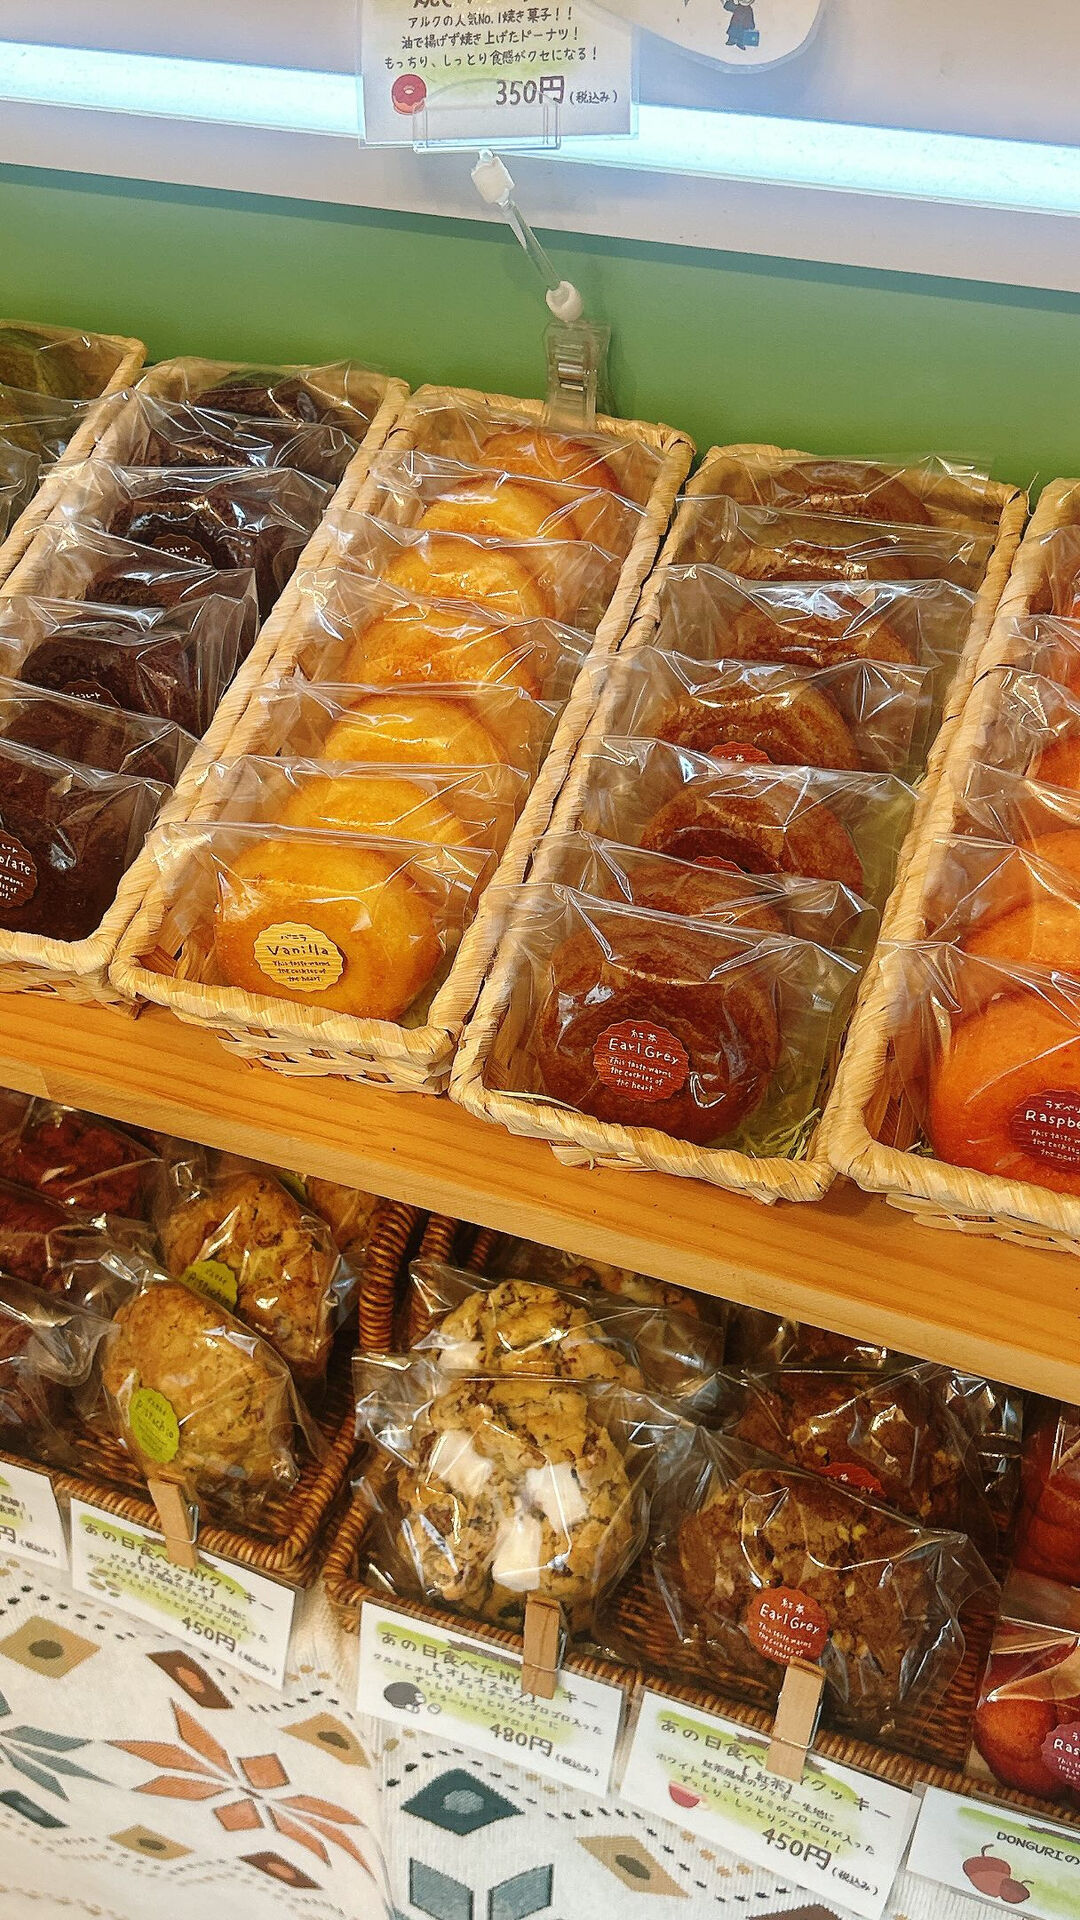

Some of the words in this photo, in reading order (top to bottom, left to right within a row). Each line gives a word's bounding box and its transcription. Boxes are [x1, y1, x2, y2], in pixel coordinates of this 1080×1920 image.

[495, 75, 565, 106] 350円
[266, 943, 330, 956] Vanilla
[608, 1038, 641, 1054] Earl
[644, 1045, 679, 1065] Grey
[181, 1614, 237, 1653] 450円
[759, 1602, 789, 1625] Earl
[789, 1615, 821, 1635] Grey
[380, 1631, 599, 1709] あの日食べたNYキー
[489, 1723, 553, 1758] 480円
[762, 1826, 833, 1871] 450円
